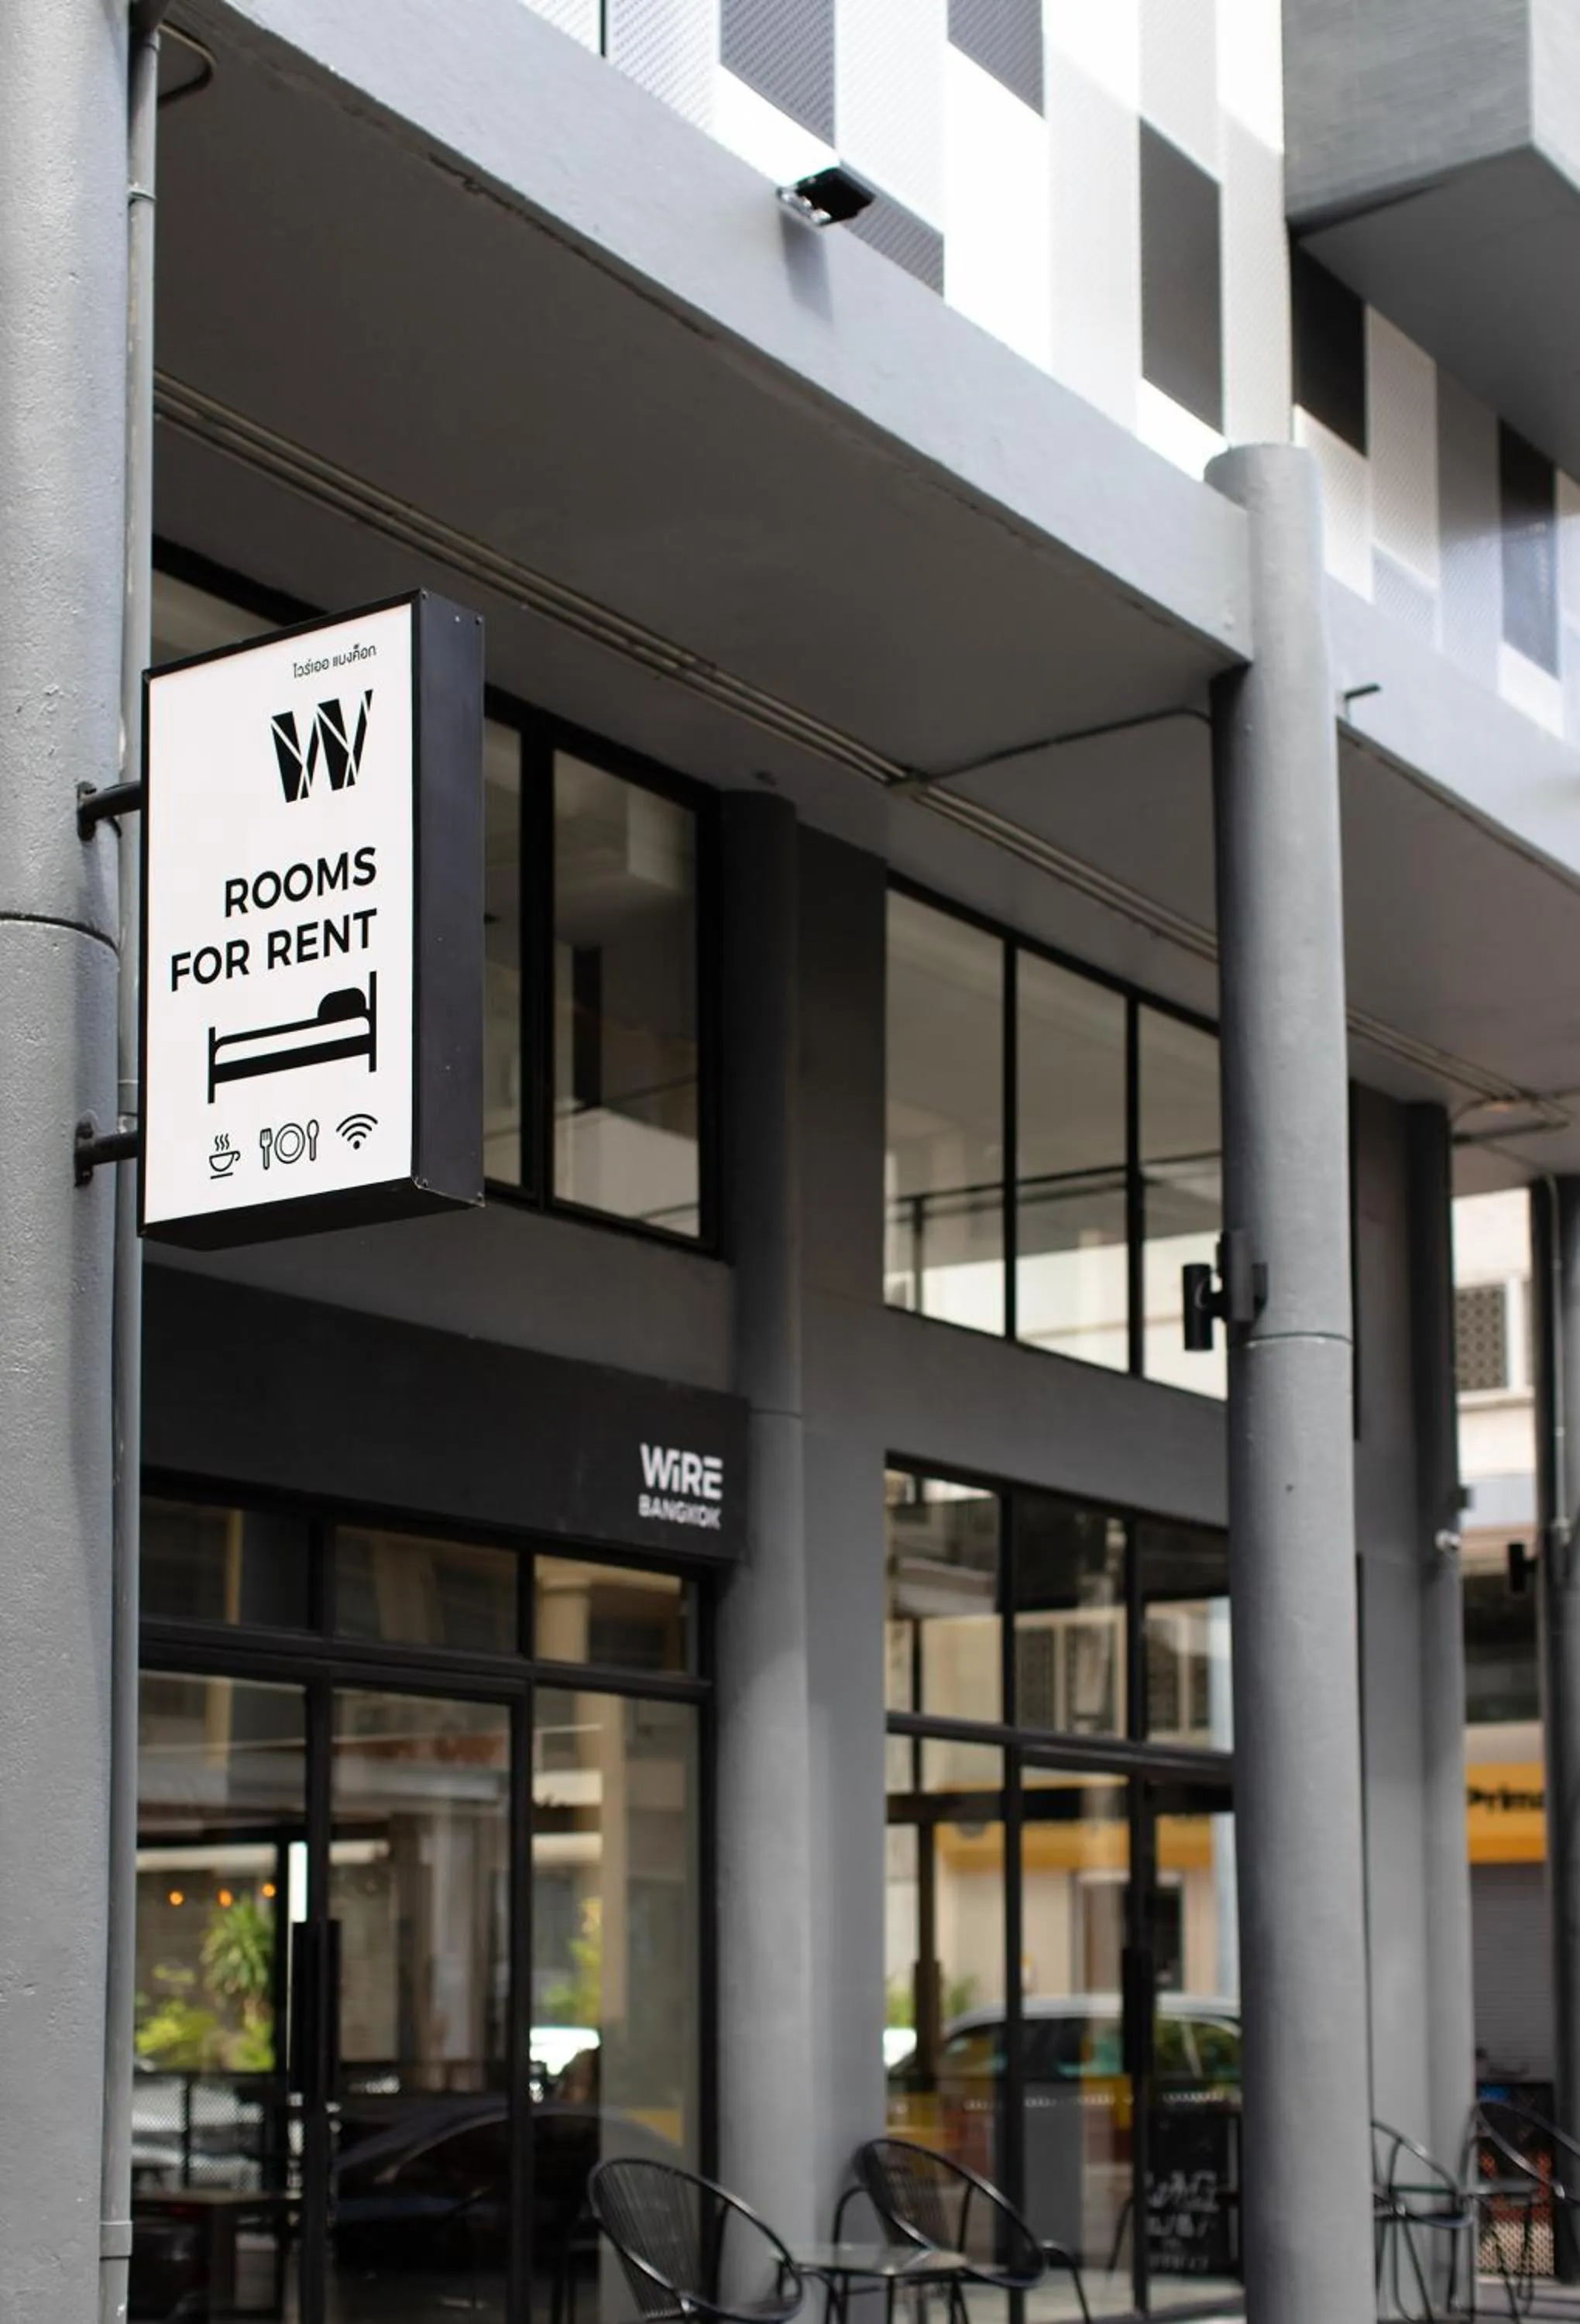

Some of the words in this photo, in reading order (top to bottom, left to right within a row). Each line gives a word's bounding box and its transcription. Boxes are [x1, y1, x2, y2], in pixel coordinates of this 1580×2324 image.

[225, 847, 377, 917] ROOMS
[171, 939, 250, 992] FOR
[267, 908, 377, 970] RENT
[638, 1493, 721, 1530] BANGKOK
